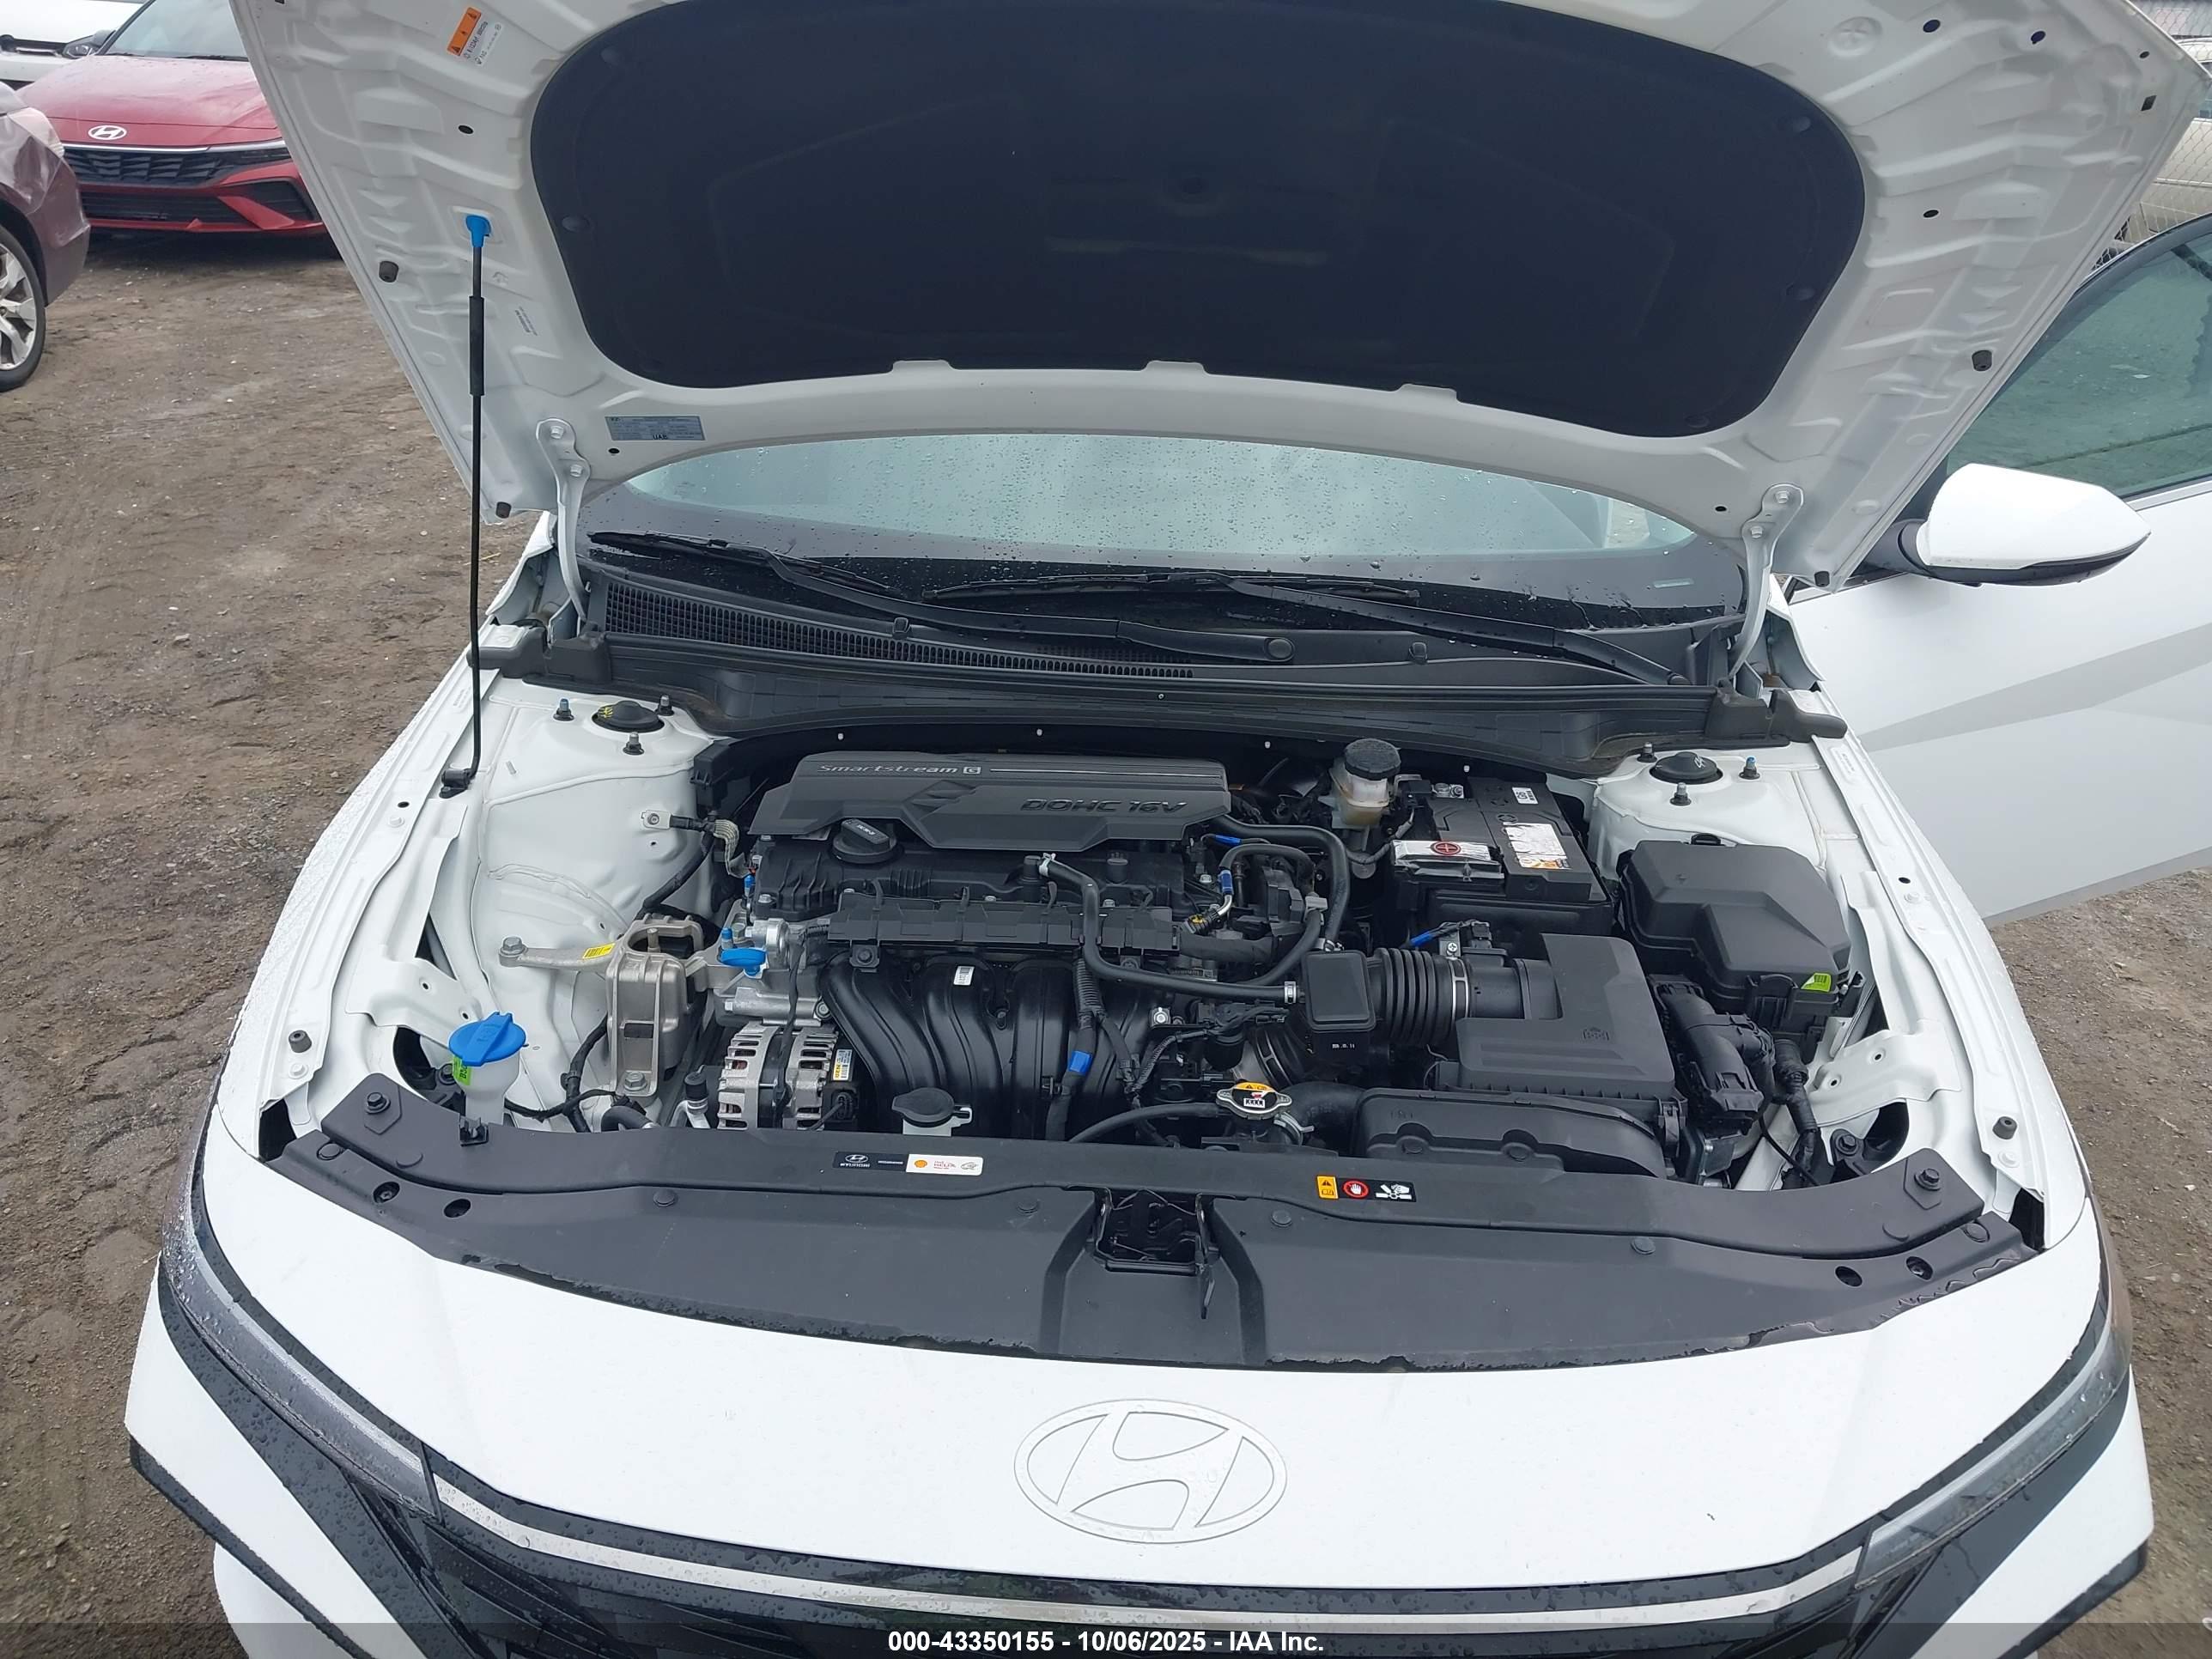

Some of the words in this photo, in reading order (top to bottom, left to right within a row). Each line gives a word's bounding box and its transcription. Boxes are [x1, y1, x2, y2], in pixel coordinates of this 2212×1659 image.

[817, 765, 958, 774] Smartstream
[1020, 799, 1123, 812] DOHC
[1127, 800, 1188, 814] 16V
